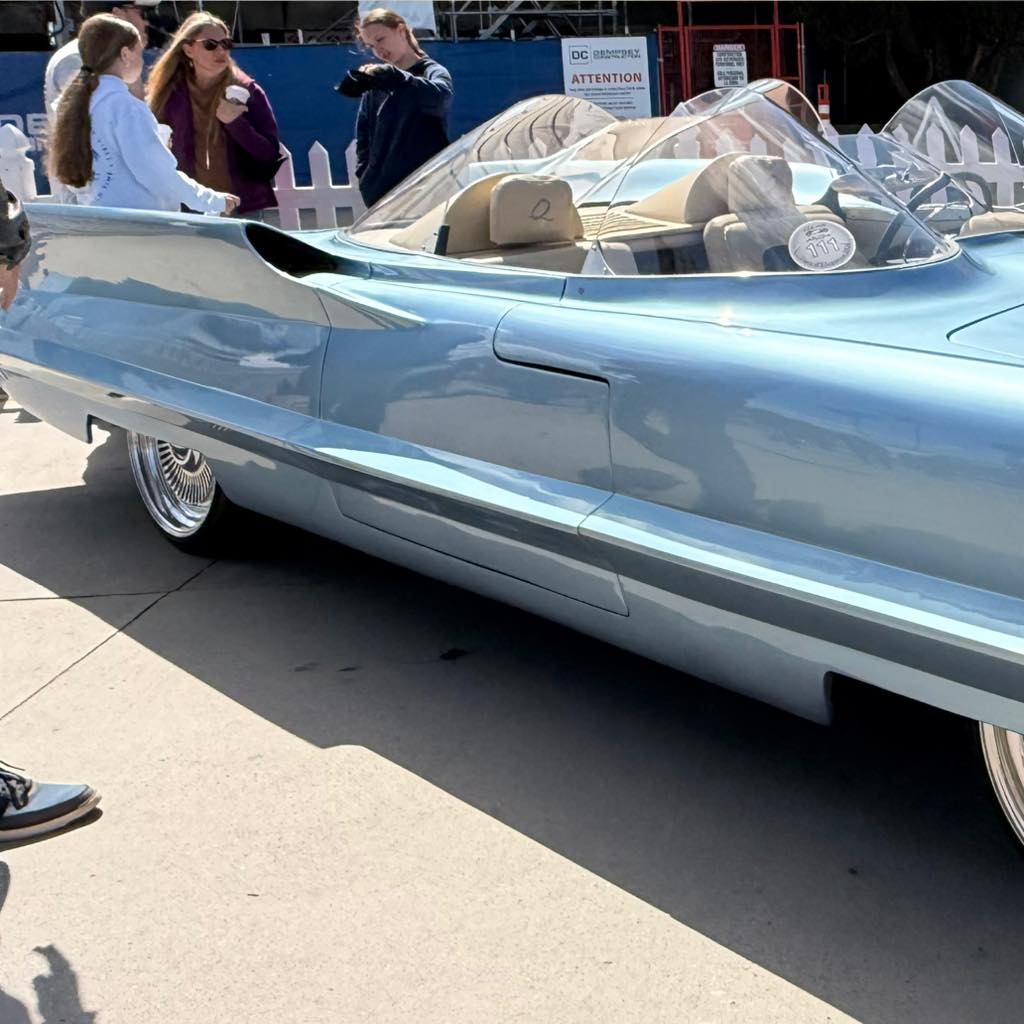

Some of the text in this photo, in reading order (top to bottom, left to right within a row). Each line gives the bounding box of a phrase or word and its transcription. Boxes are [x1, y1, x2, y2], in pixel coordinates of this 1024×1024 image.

[572, 50, 589, 60] DC
[571, 72, 642, 84] ATTENTION
[806, 237, 840, 258] 111
